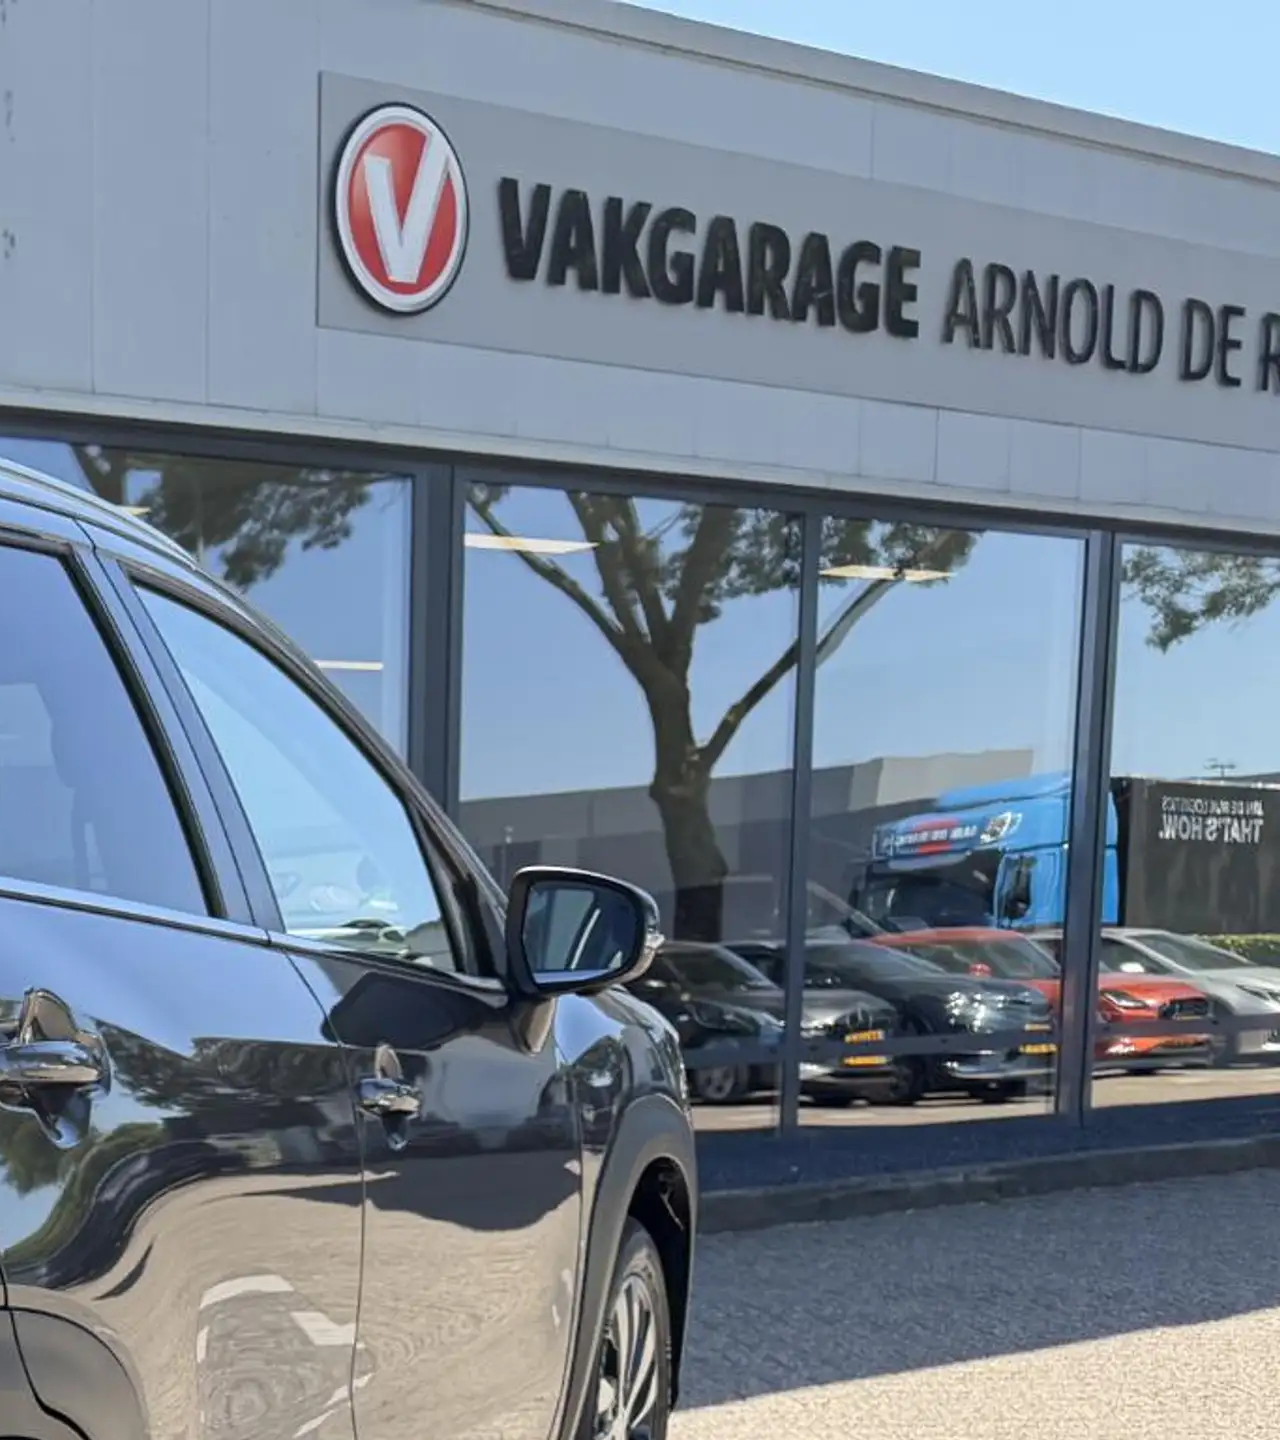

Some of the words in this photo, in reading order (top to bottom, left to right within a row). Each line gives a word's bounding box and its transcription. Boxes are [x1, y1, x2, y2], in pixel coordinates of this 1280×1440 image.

[498, 176, 921, 338] VAKGARAGE
[940, 257, 1164, 374] ARNOLD
[1178, 297, 1246, 387] DE
